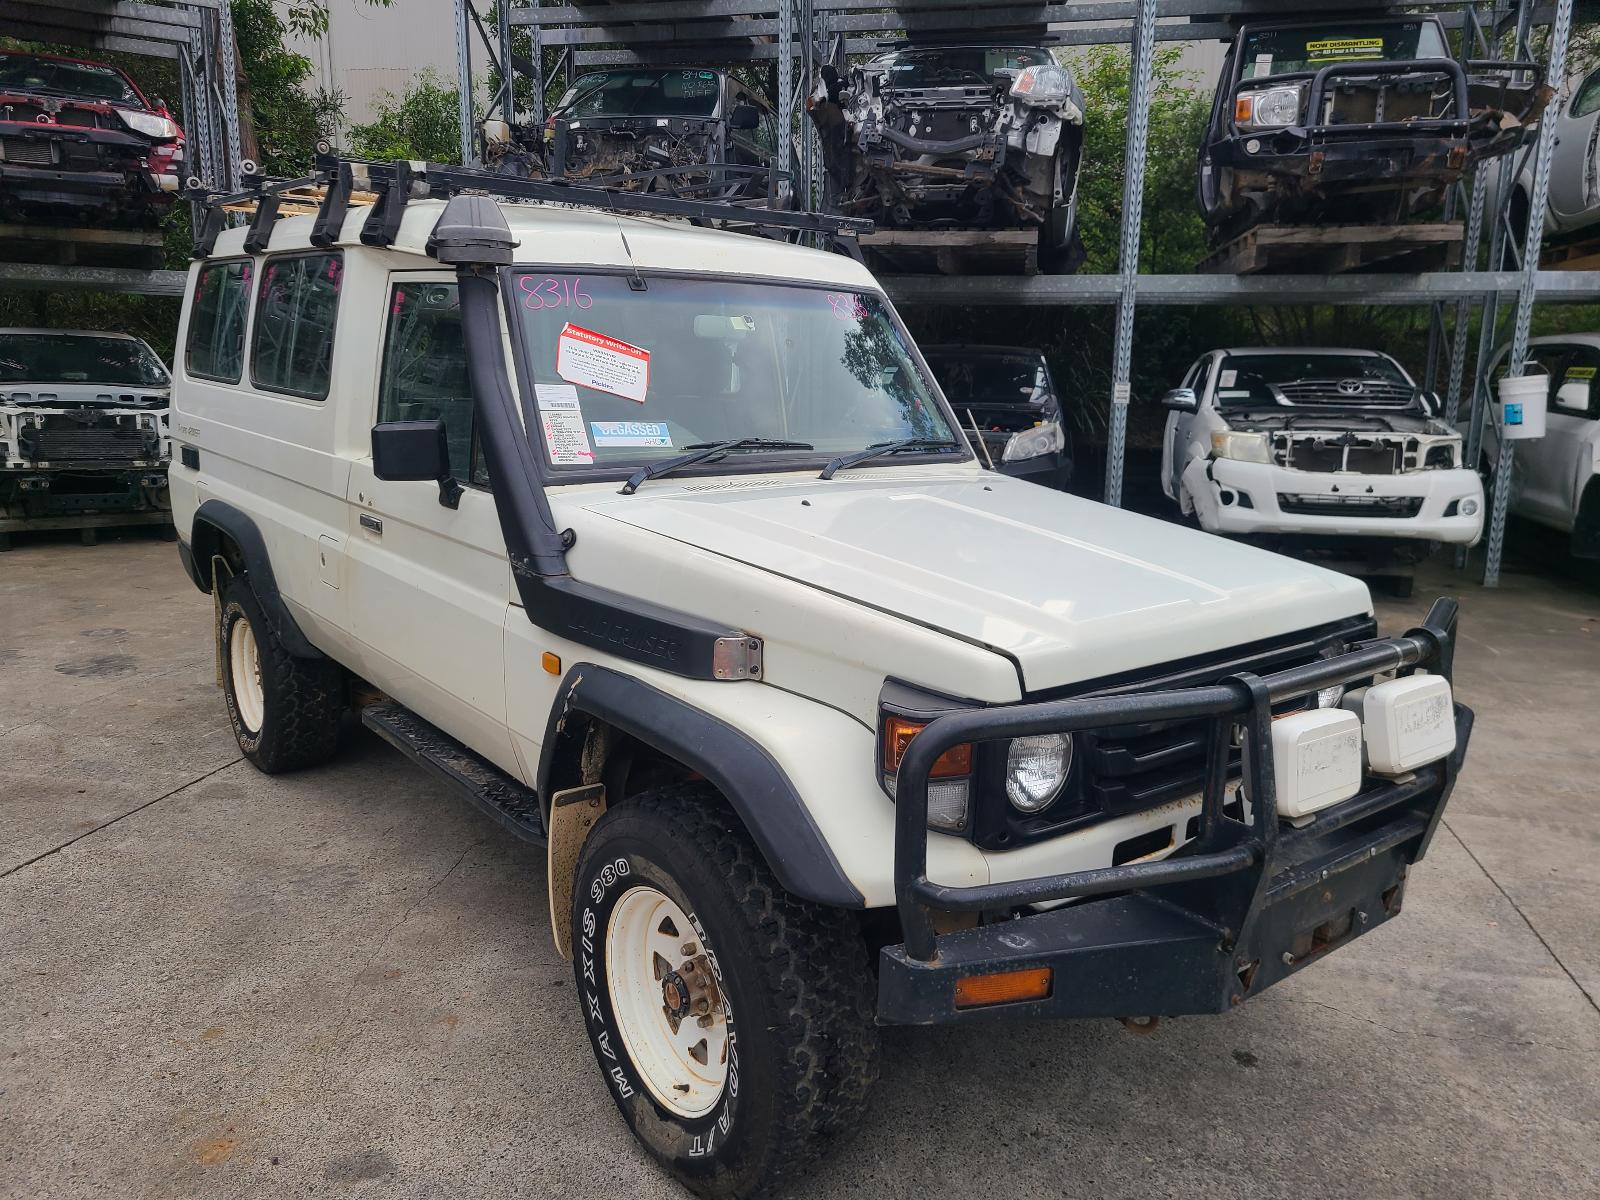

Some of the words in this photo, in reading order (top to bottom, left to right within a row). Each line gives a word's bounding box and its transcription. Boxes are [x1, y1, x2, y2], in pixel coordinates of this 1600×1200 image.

[1329, 40, 1380, 48] DISMANTLING
[520, 276, 593, 310] 8316
[566, 327, 605, 345] Statutory
[605, 338, 643, 356] Write-Off
[590, 857, 631, 904] 980
[582, 907, 634, 1100] MAXXIS
